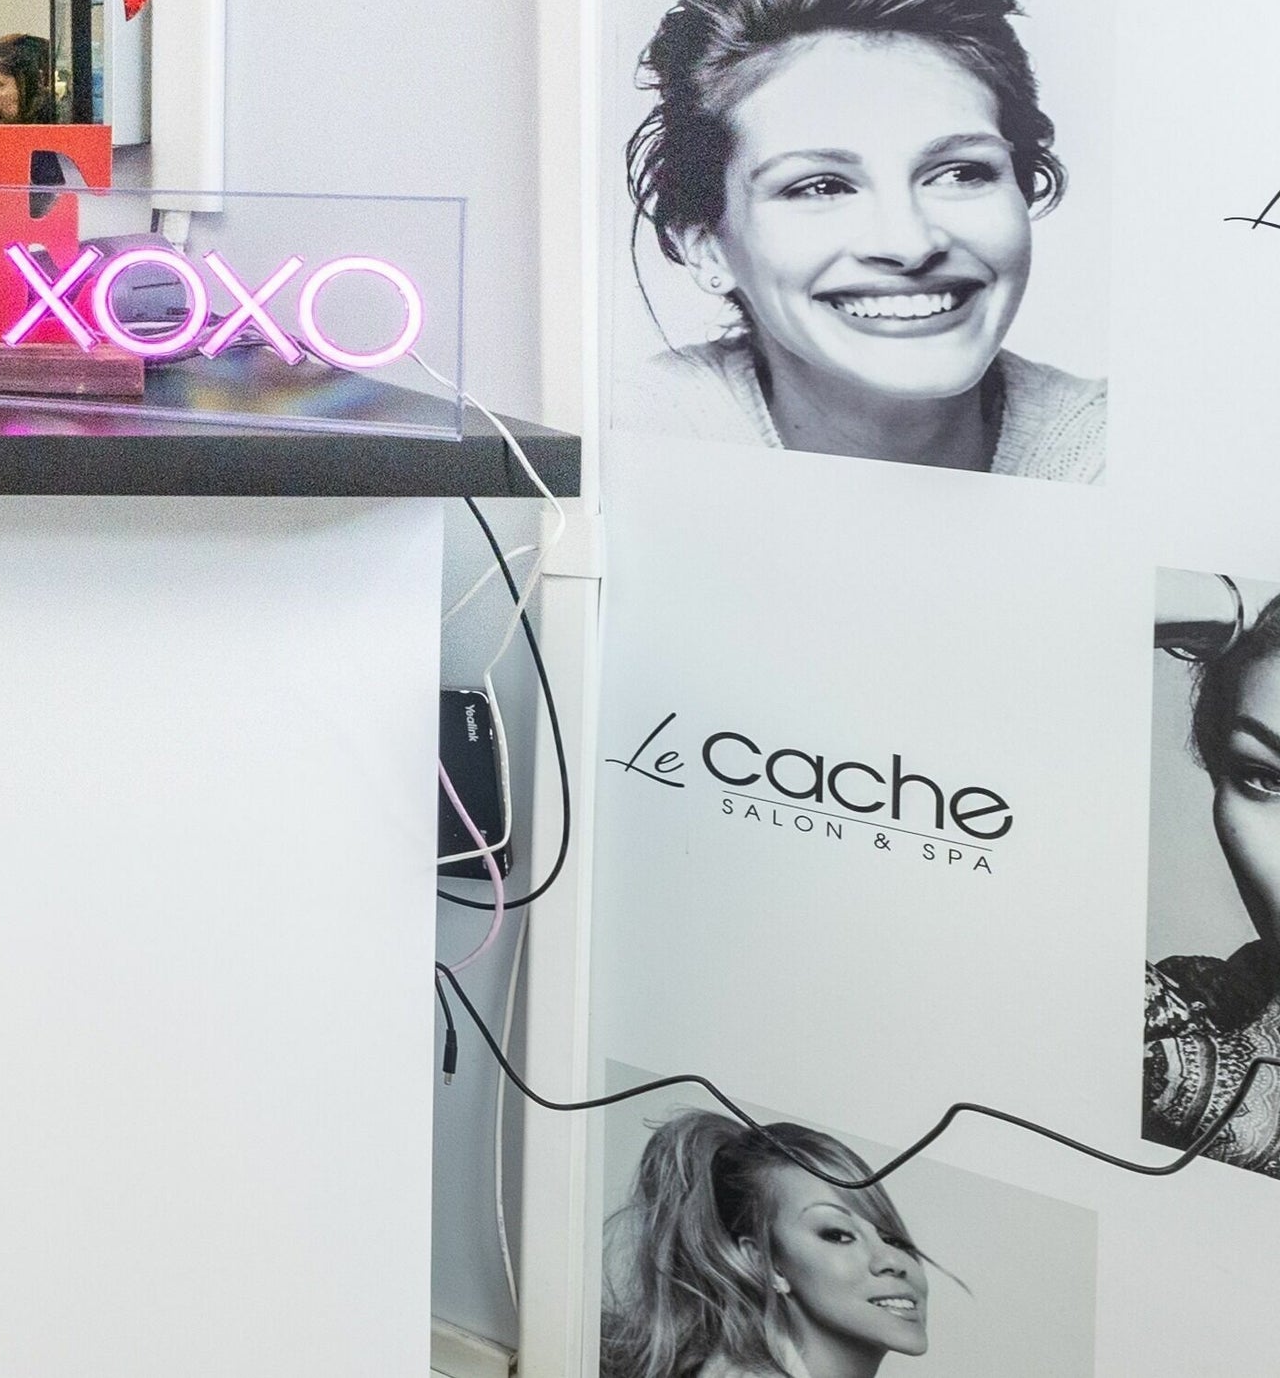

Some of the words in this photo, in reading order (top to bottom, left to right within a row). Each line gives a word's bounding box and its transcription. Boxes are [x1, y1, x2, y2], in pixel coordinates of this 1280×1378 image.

[2, 240, 426, 370] XOXO
[464, 703, 478, 743] Yealink
[605, 712, 686, 788] Le
[702, 731, 1014, 841] cache
[722, 798, 843, 840] SALON
[874, 833, 892, 851] &
[922, 843, 994, 875] SPA
